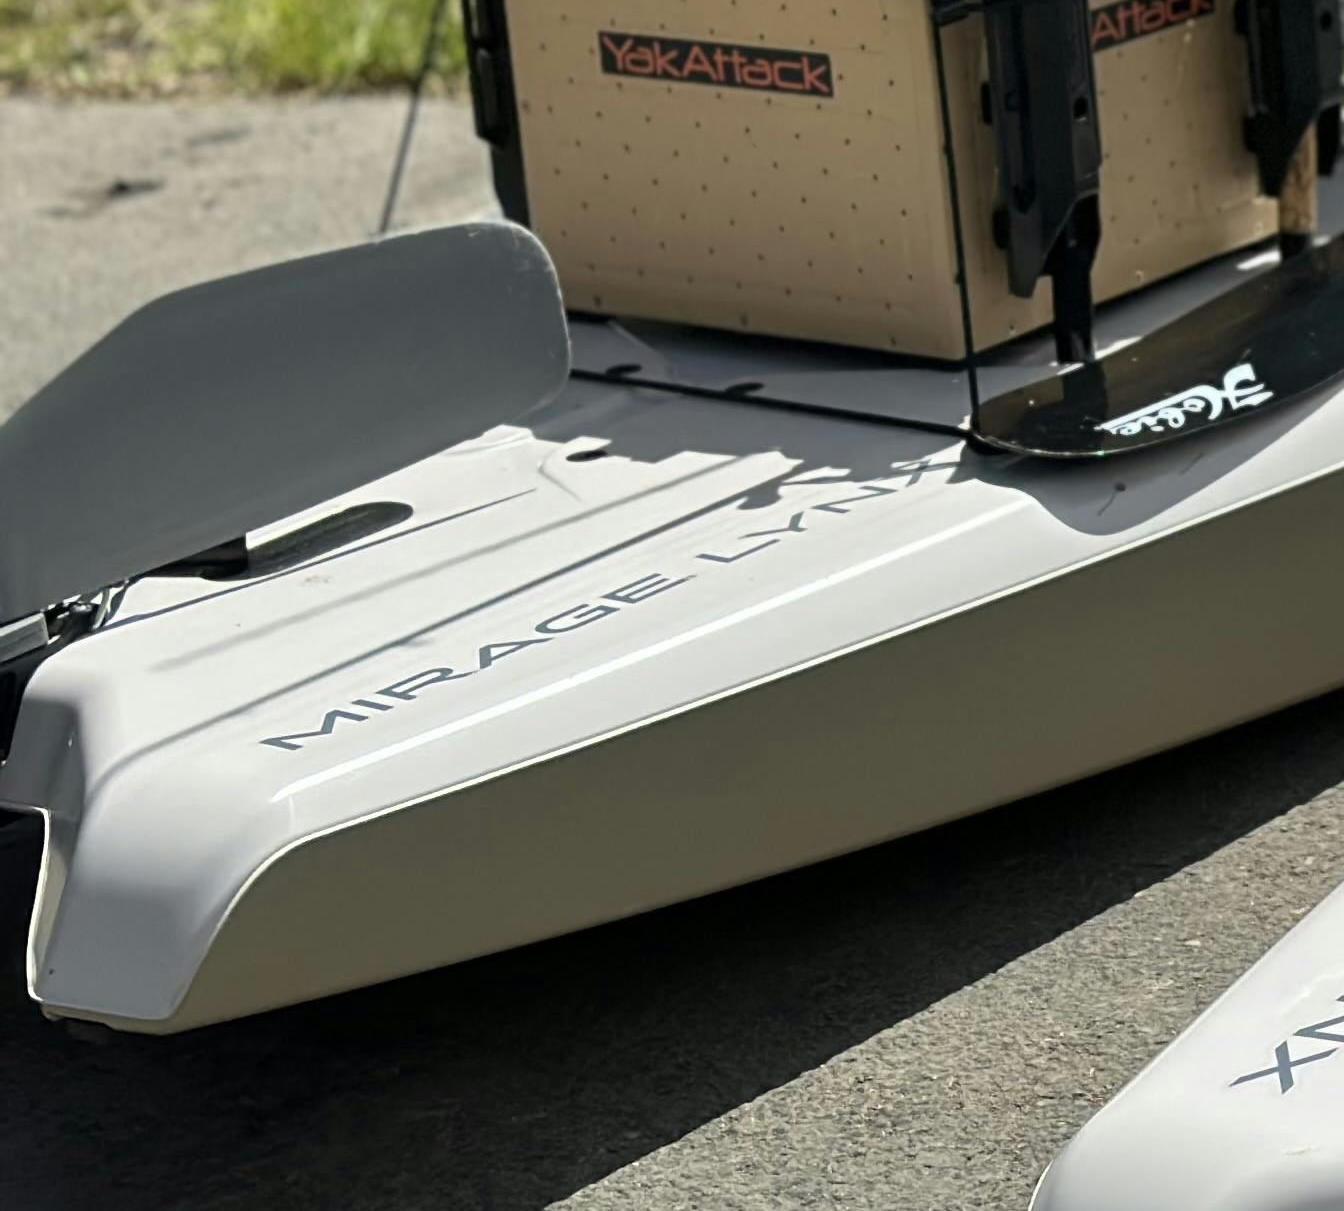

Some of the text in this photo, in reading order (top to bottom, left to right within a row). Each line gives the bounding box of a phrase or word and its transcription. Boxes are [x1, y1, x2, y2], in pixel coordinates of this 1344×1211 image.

[602, 35, 830, 94] YakAttack
[1093, 362, 1275, 436] Hobie
[259, 458, 962, 751] MIRAGE LYNX
